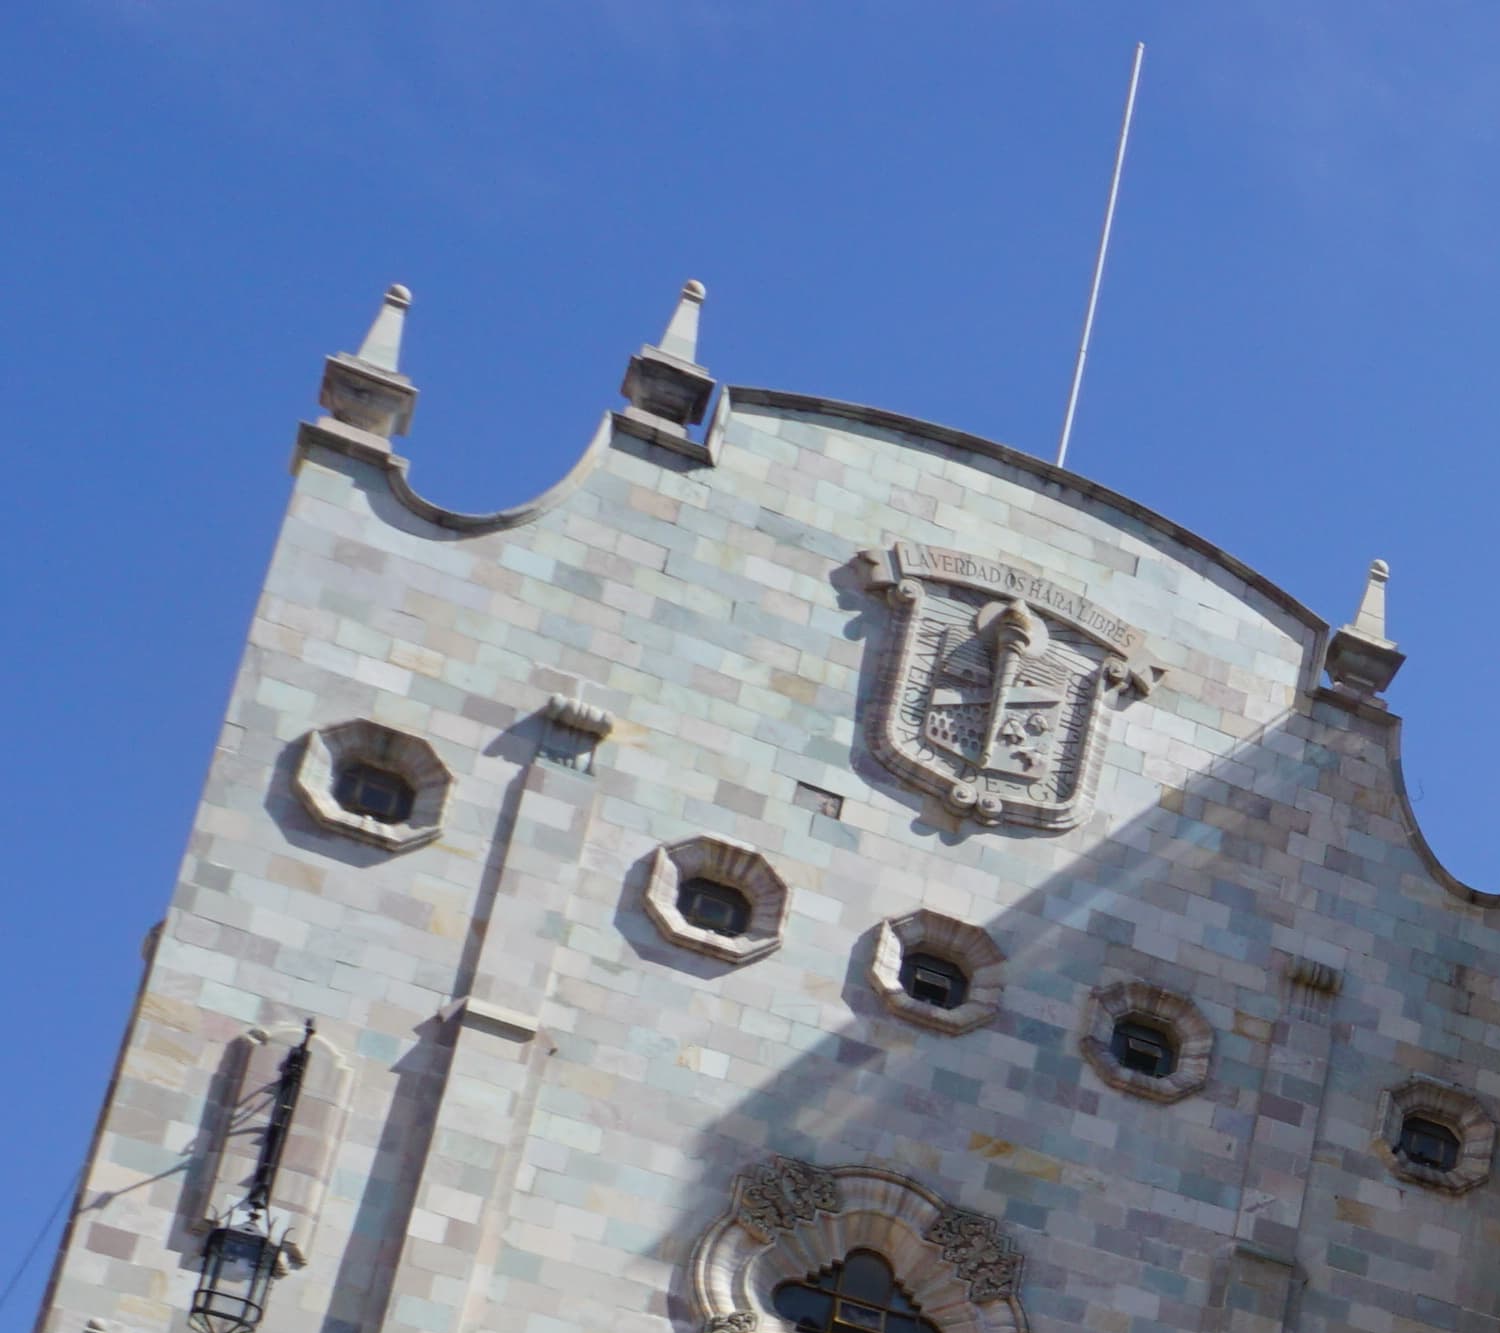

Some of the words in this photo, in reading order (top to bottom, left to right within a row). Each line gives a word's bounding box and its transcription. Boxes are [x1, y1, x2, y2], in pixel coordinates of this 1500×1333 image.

[928, 551, 1001, 585] VERDAD
[1004, 567, 1026, 593] OS
[1029, 583, 1074, 617] HARA
[1076, 604, 1137, 649] LIBRES
